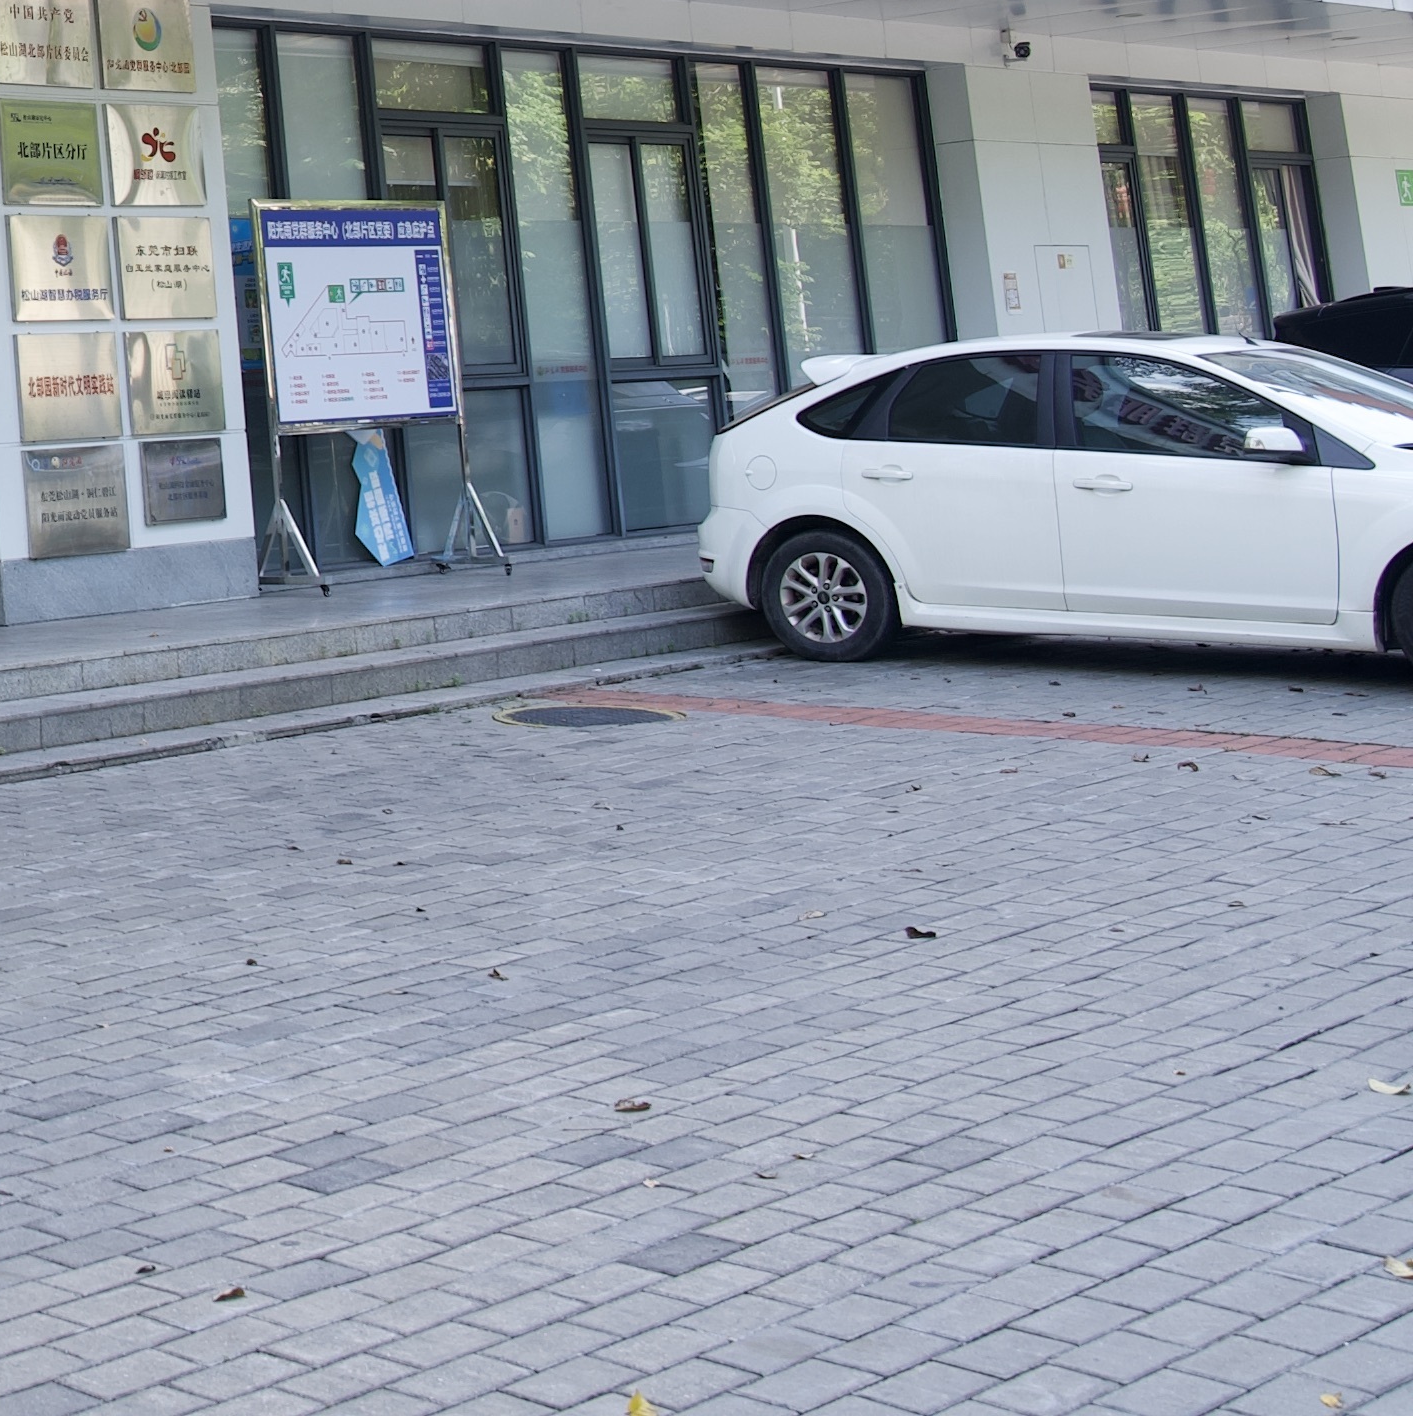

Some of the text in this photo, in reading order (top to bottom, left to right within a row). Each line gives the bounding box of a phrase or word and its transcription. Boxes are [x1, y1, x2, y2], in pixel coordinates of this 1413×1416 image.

[9, 3, 75, 24] 中国共产党
[18, 141, 88, 161] 北部片区分厅
[135, 244, 198, 257] 东莞市妇联
[21, 288, 108, 302] 松山湖智慧办税服务厅
